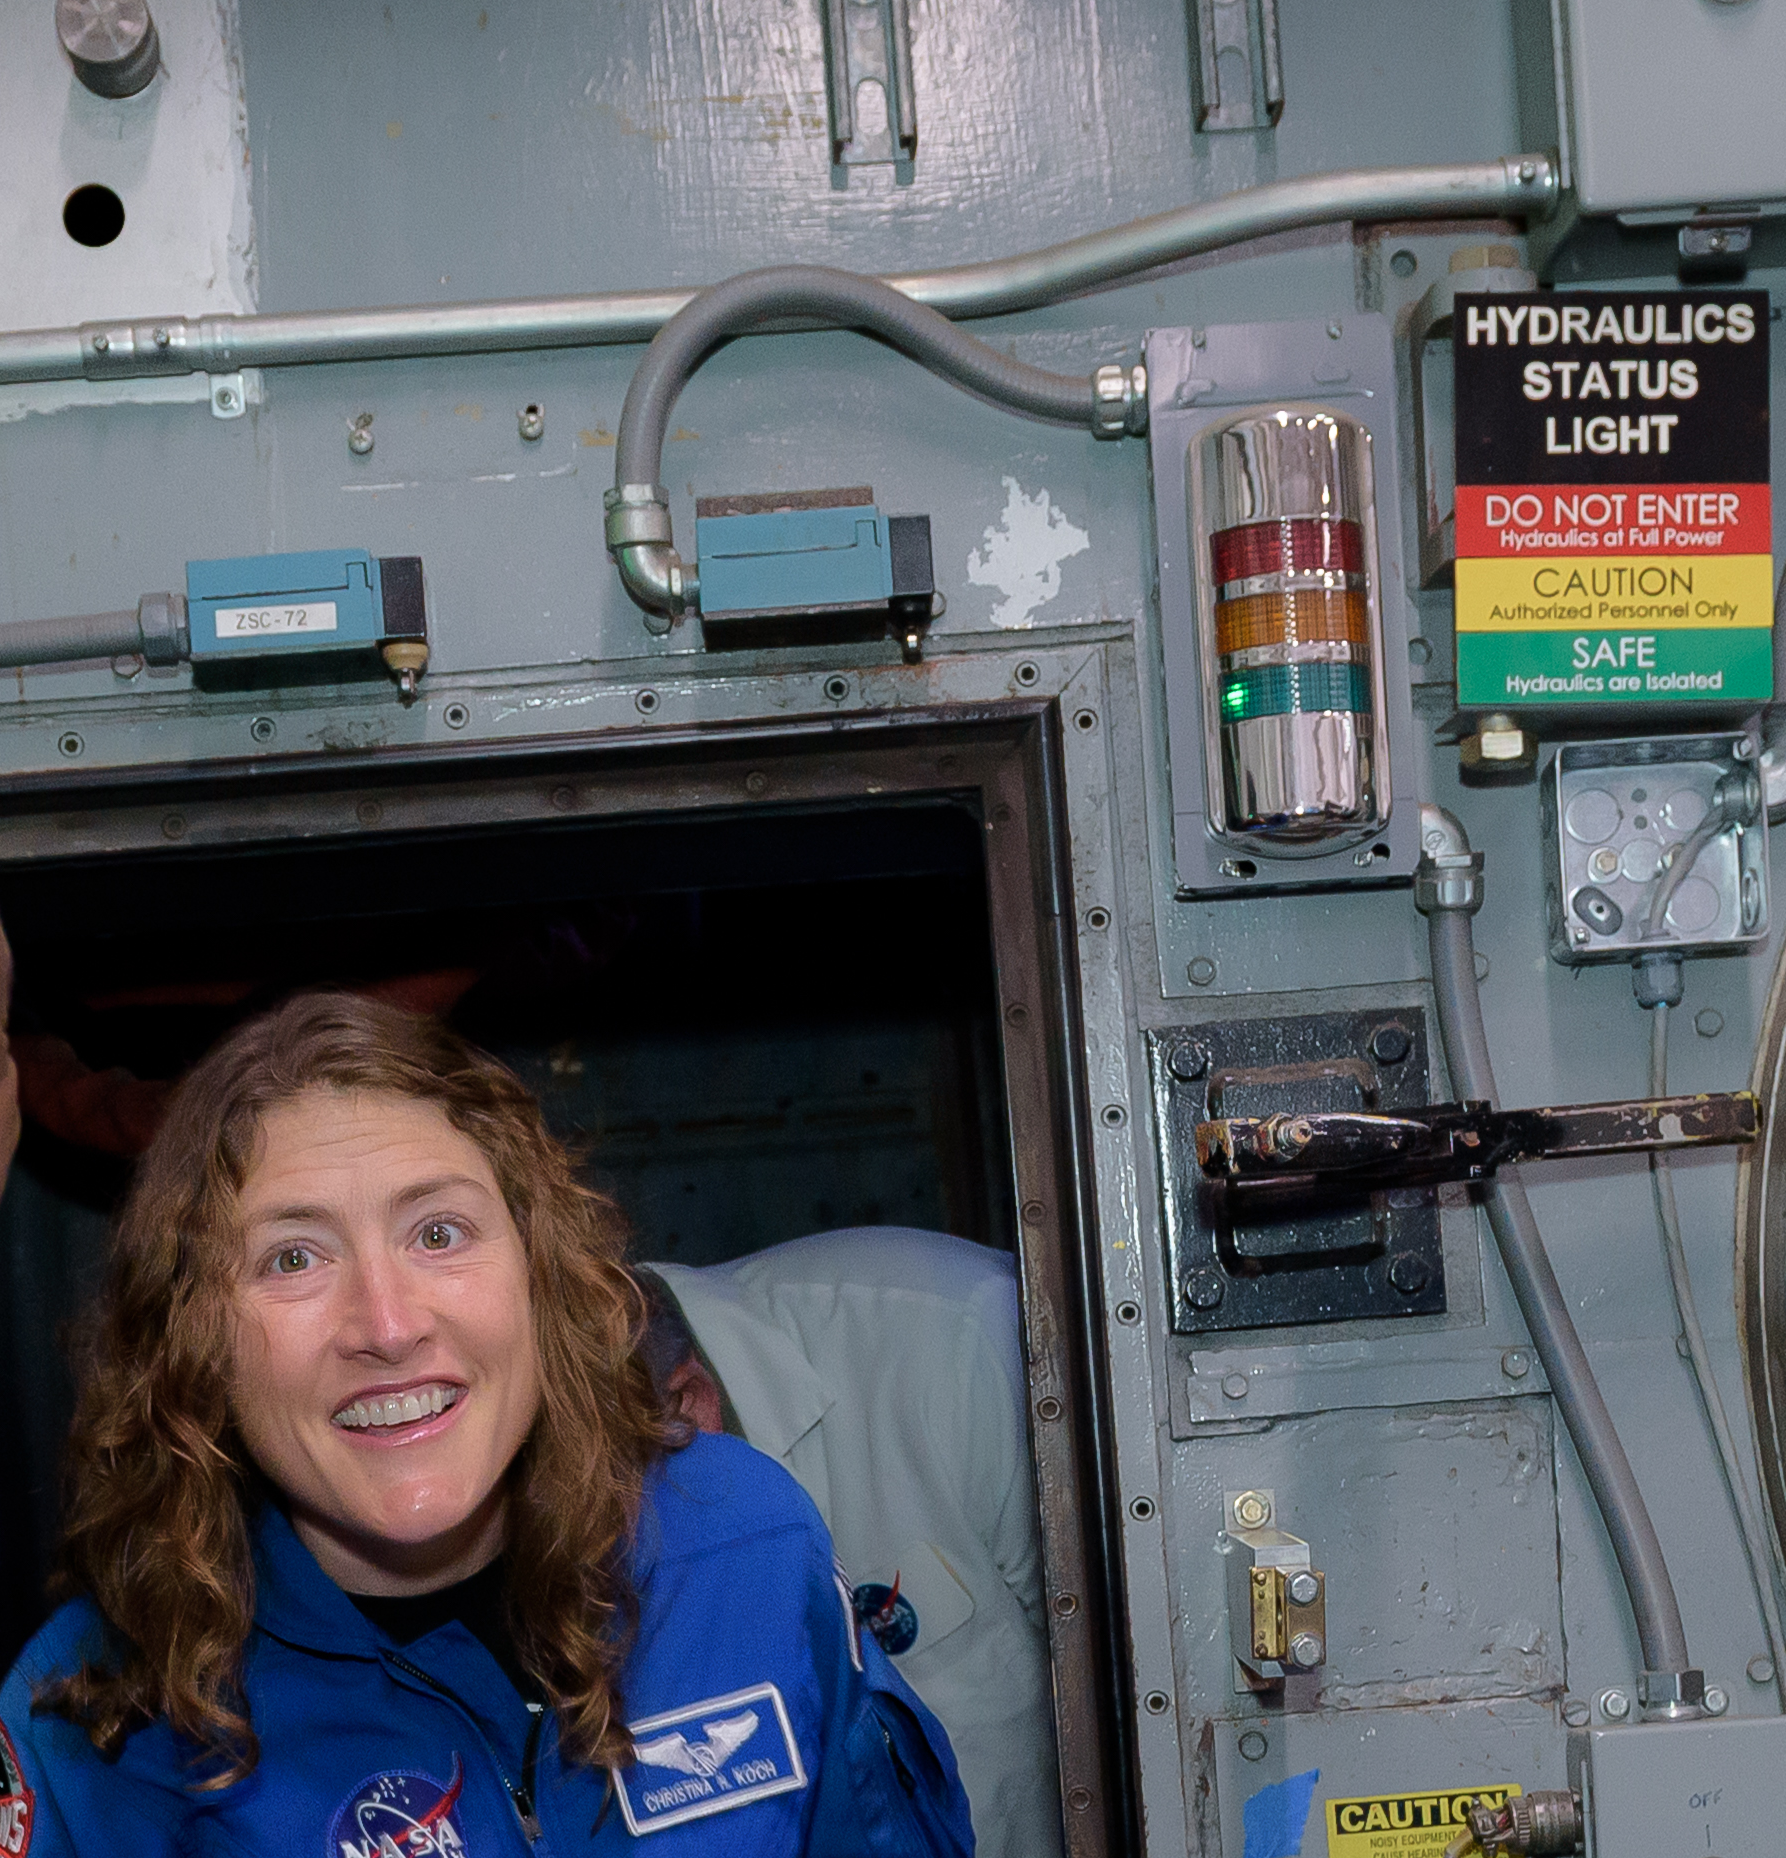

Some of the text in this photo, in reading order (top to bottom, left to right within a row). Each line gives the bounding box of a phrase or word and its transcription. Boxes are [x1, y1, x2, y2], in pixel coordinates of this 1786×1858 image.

[1466, 302, 1757, 346] HYDRAULICS
[1522, 359, 1699, 401] STATUS
[1546, 413, 1679, 455] LIGHT
[1485, 492, 1740, 527] DO NOT ENTER
[1500, 527, 1724, 551] Hydraulics at Full Power
[1533, 566, 1694, 598] CAUTION
[235, 608, 308, 630] ZSC-72
[1489, 600, 1739, 621] Authorized Personnel Only
[1572, 636, 1656, 669] SAFE
[1506, 670, 1723, 696] Hydraulics are Isolated
[642, 1777, 715, 1813] CHRISTINA
[731, 1757, 778, 1787] KOCH
[1688, 1787, 1723, 1809] OFF
[1369, 1831, 1457, 1848] NOISY EQUIPMENT
